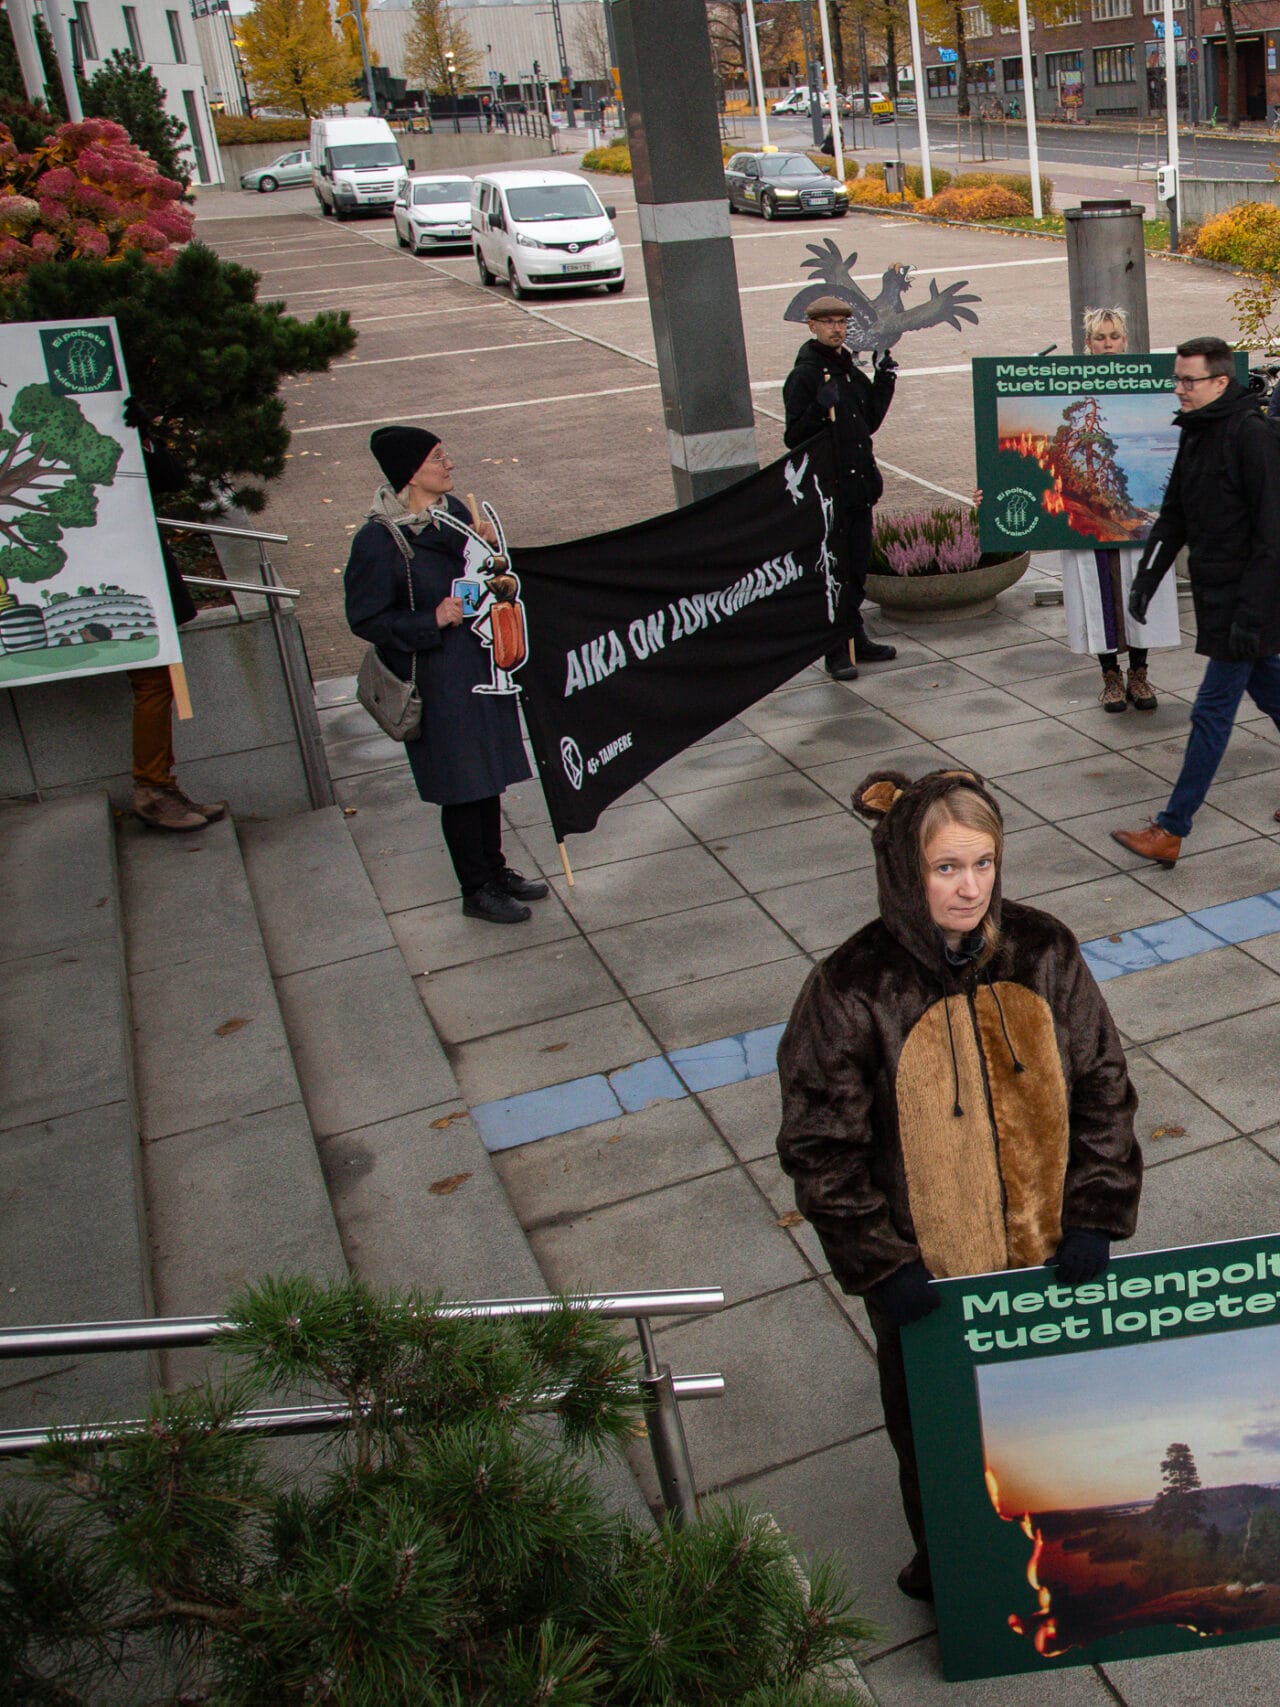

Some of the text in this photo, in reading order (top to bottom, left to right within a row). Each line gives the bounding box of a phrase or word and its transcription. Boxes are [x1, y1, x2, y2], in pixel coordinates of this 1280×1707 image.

[52, 329, 107, 348] Ei polteta
[53, 365, 114, 393] tulevaisuutta
[996, 361, 1152, 379] Metsienpolton
[996, 377, 1176, 394] tuet lopetettava
[564, 550, 804, 698] AIKA ON LOPPUMASSA.
[598, 731, 633, 766] TAMPERE
[964, 1316, 1091, 1353] tuet
